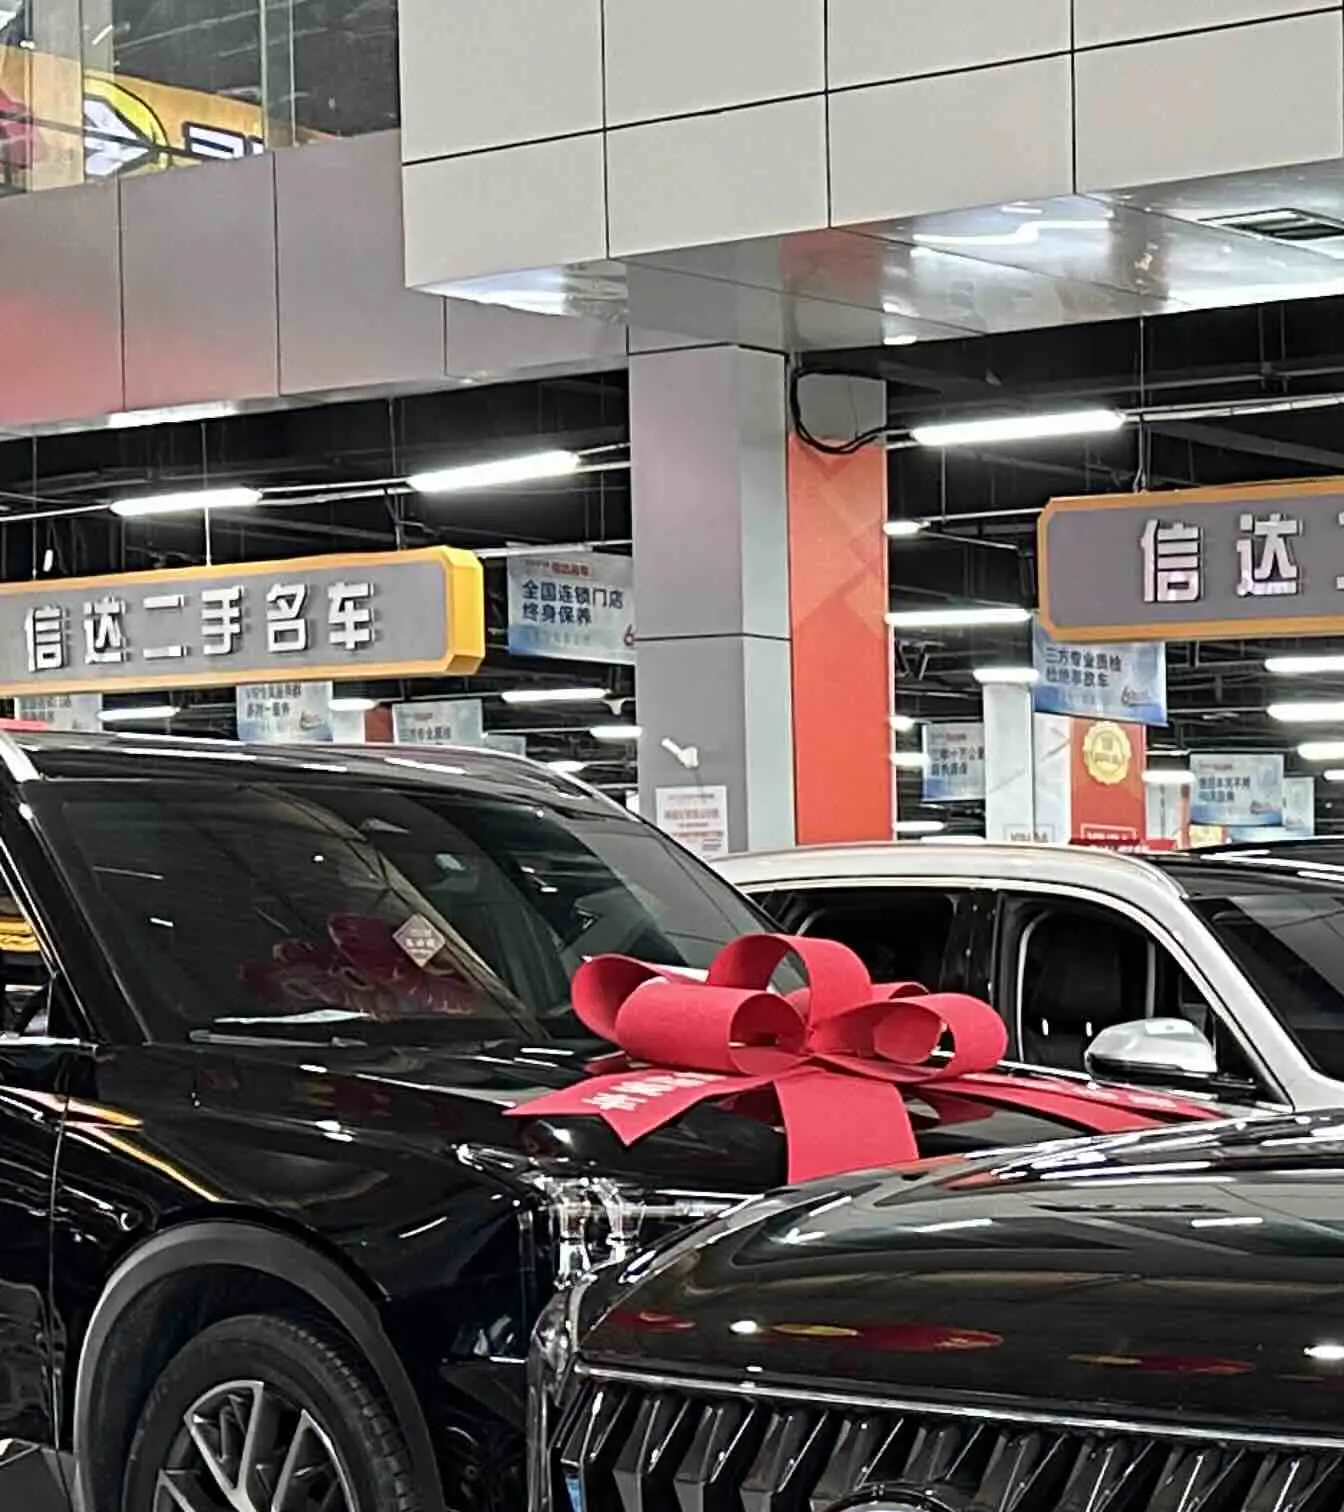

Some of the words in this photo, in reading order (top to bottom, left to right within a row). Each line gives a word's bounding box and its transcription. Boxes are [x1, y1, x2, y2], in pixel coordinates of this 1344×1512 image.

[522, 579, 624, 610] 全国连锁门店
[24, 582, 376, 673] 信达二手名车
[522, 602, 592, 626] 终身保养
